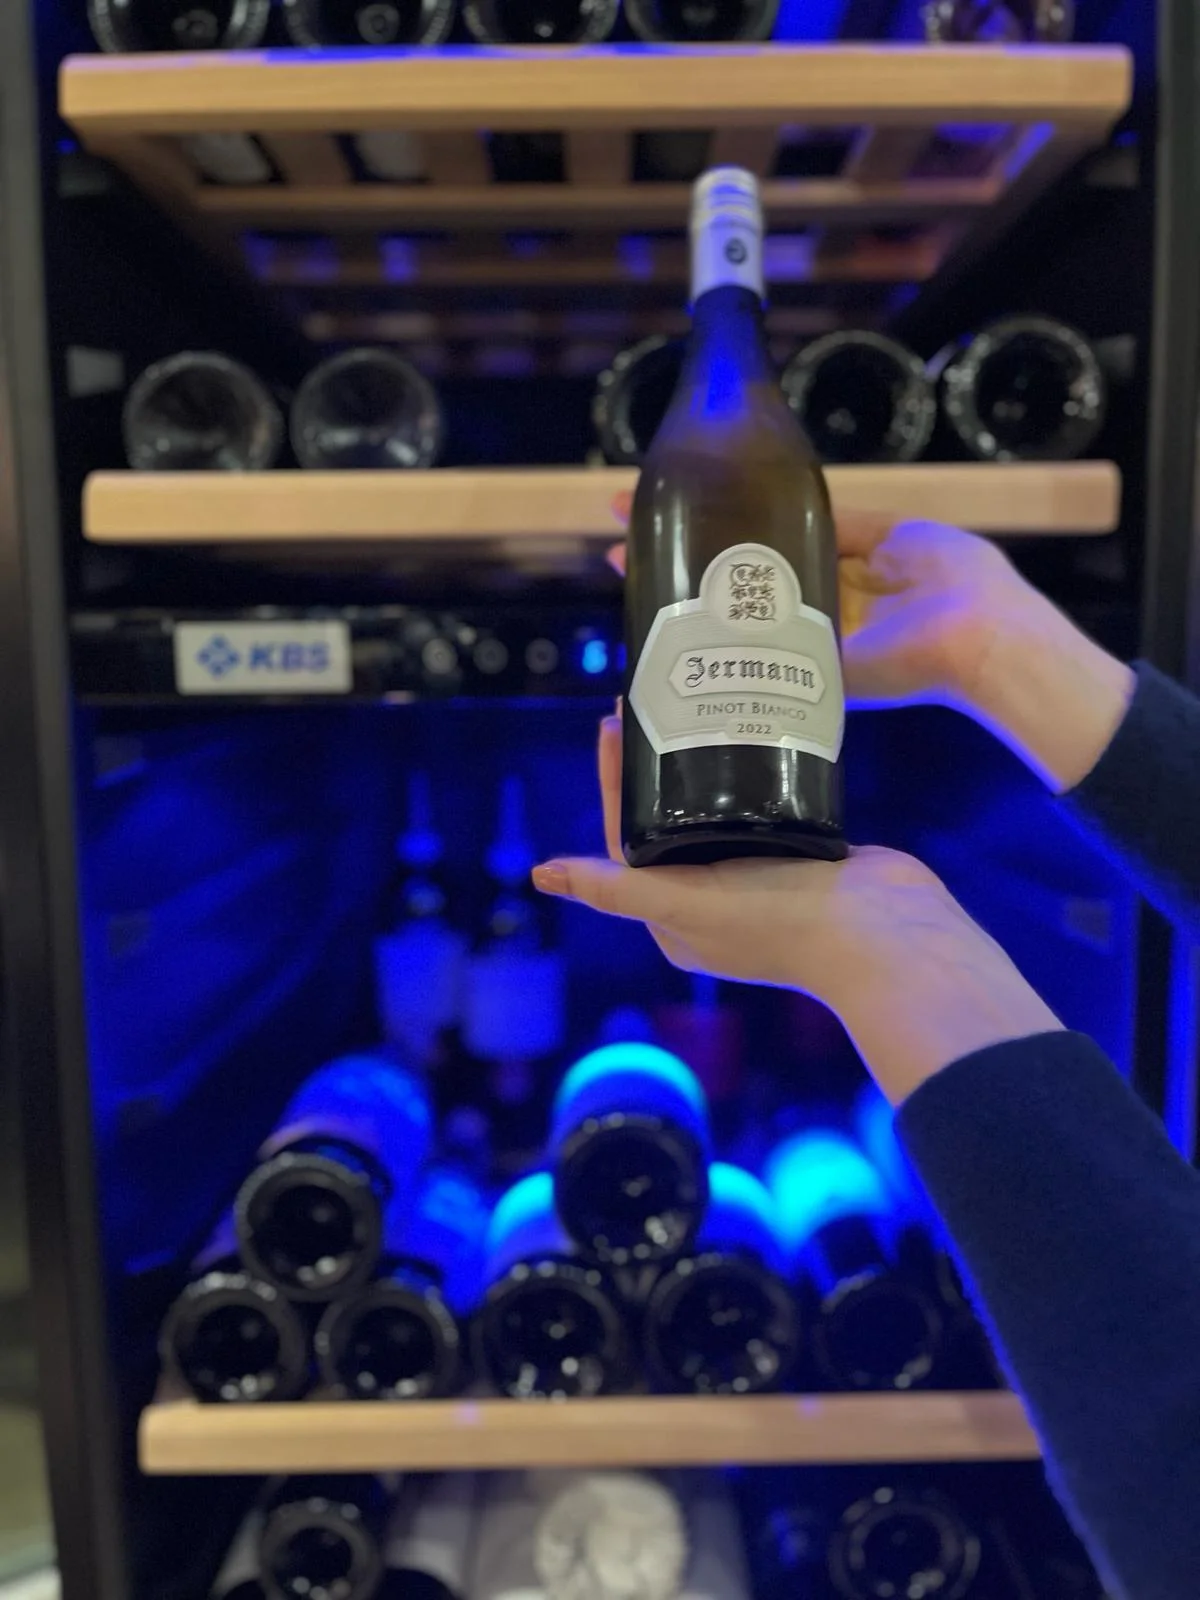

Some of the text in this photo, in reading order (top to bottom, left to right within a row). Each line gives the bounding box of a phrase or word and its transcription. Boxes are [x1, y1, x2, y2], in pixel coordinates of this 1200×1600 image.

[249, 640, 330, 673] KBS
[684, 656, 816, 689] Jermann
[696, 701, 807, 721] PINOT BIANCO
[737, 723, 772, 735] 2022
